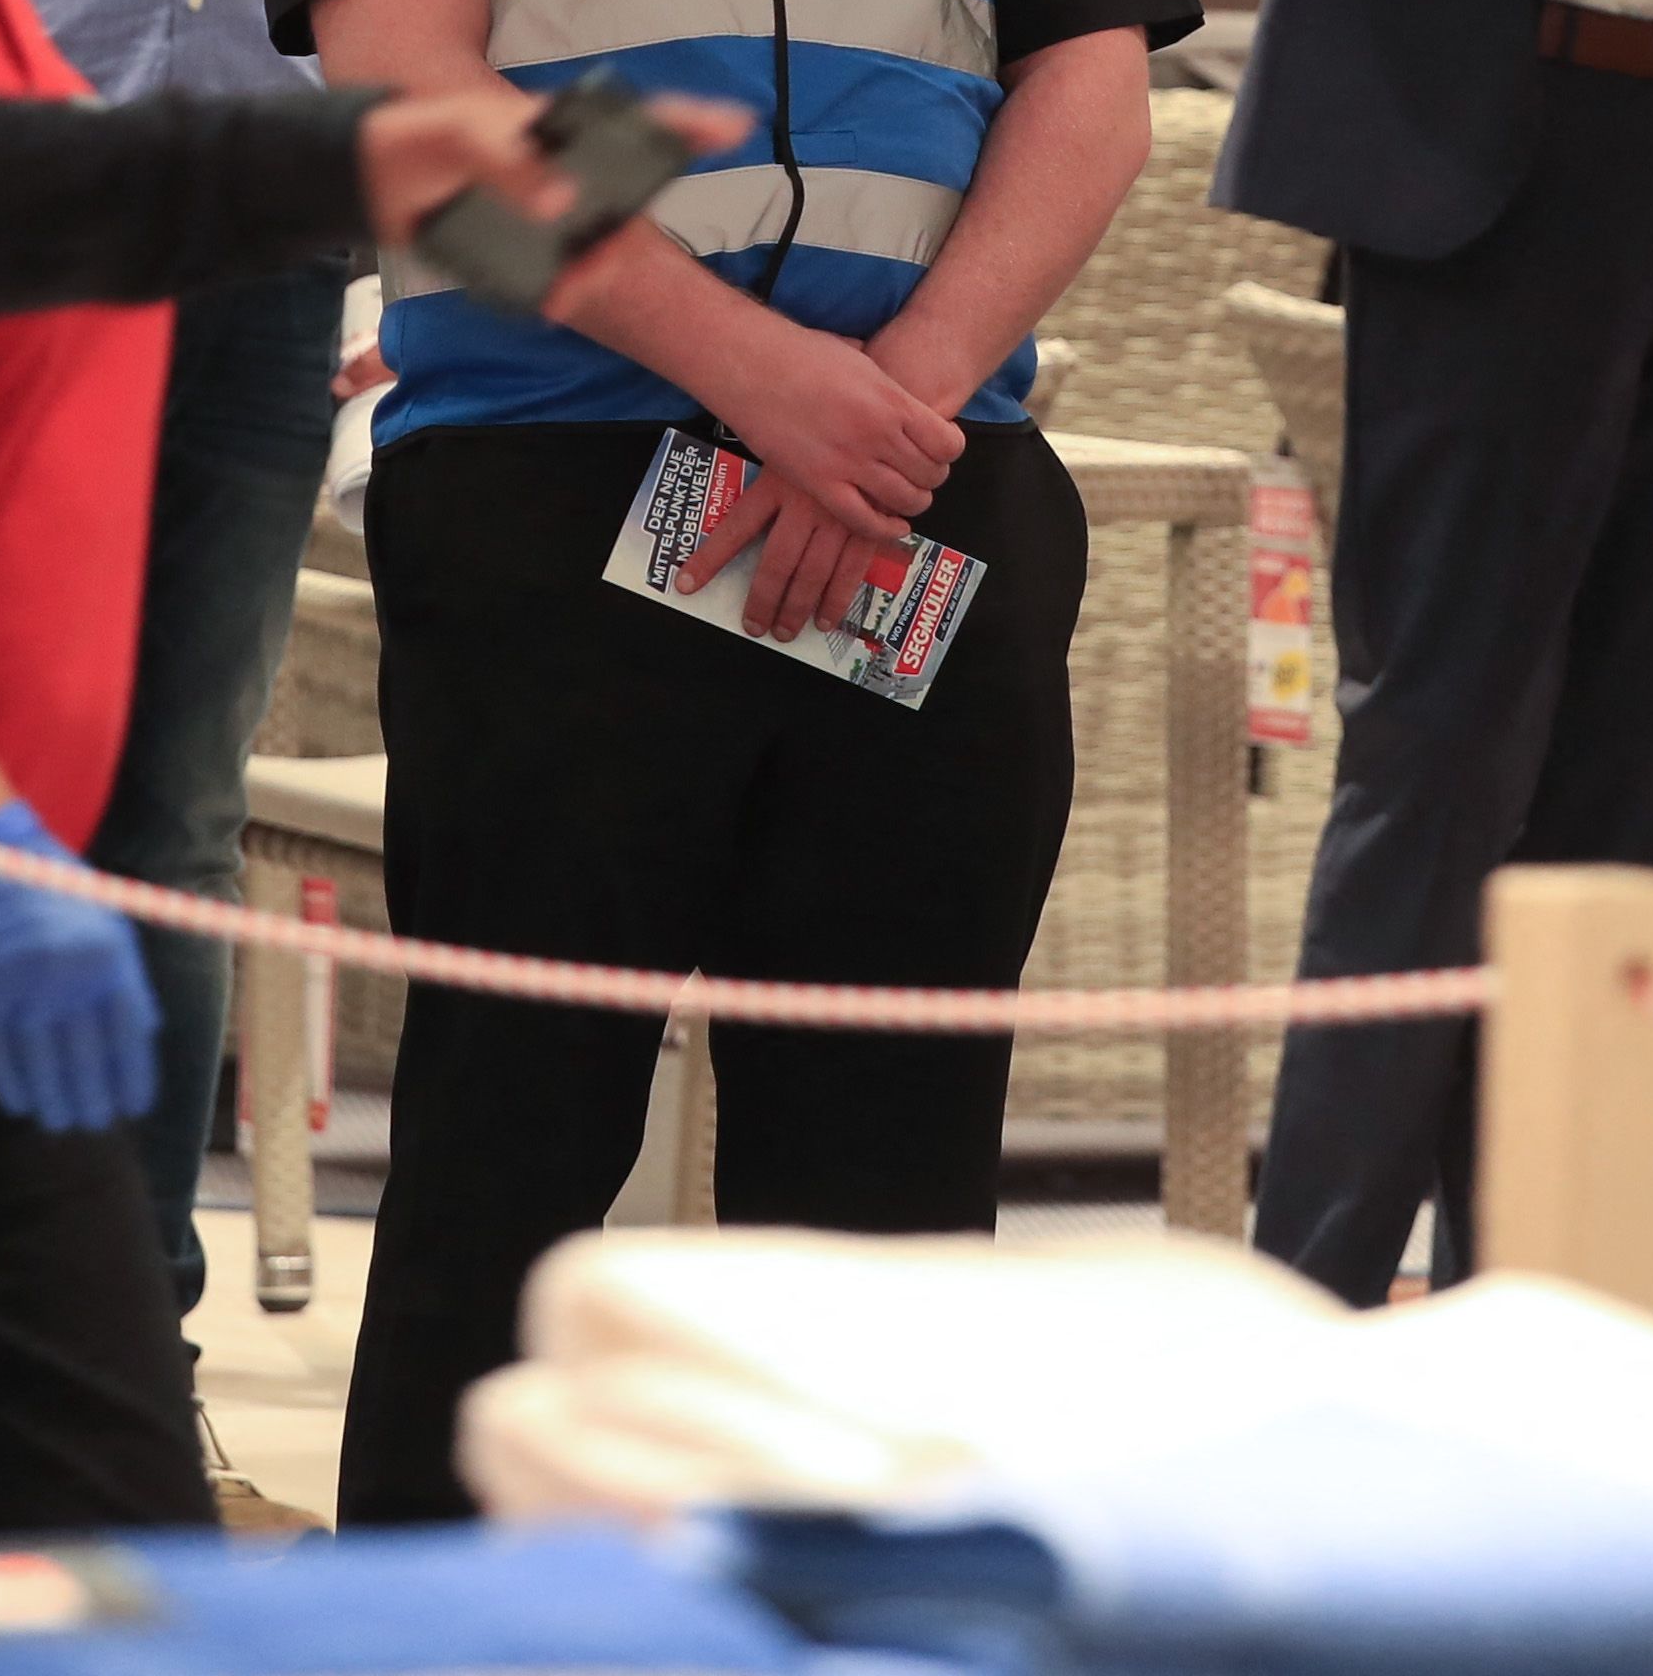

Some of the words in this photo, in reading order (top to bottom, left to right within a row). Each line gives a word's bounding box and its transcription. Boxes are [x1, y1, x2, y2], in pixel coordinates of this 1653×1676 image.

[648, 497, 668, 531] DER
[659, 449, 685, 497] NEUE
[651, 480, 688, 585] MITTELPUNKT
[680, 445, 700, 478] DER
[676, 456, 712, 562] MÖBELWELT.
[708, 463, 728, 517] Pulheim
[911, 583, 924, 601] ICH
[917, 559, 935, 584] WAS?
[889, 625, 903, 642] WO
[897, 600, 916, 627] FINDE
[902, 558, 959, 670] SEGMÜLLER
